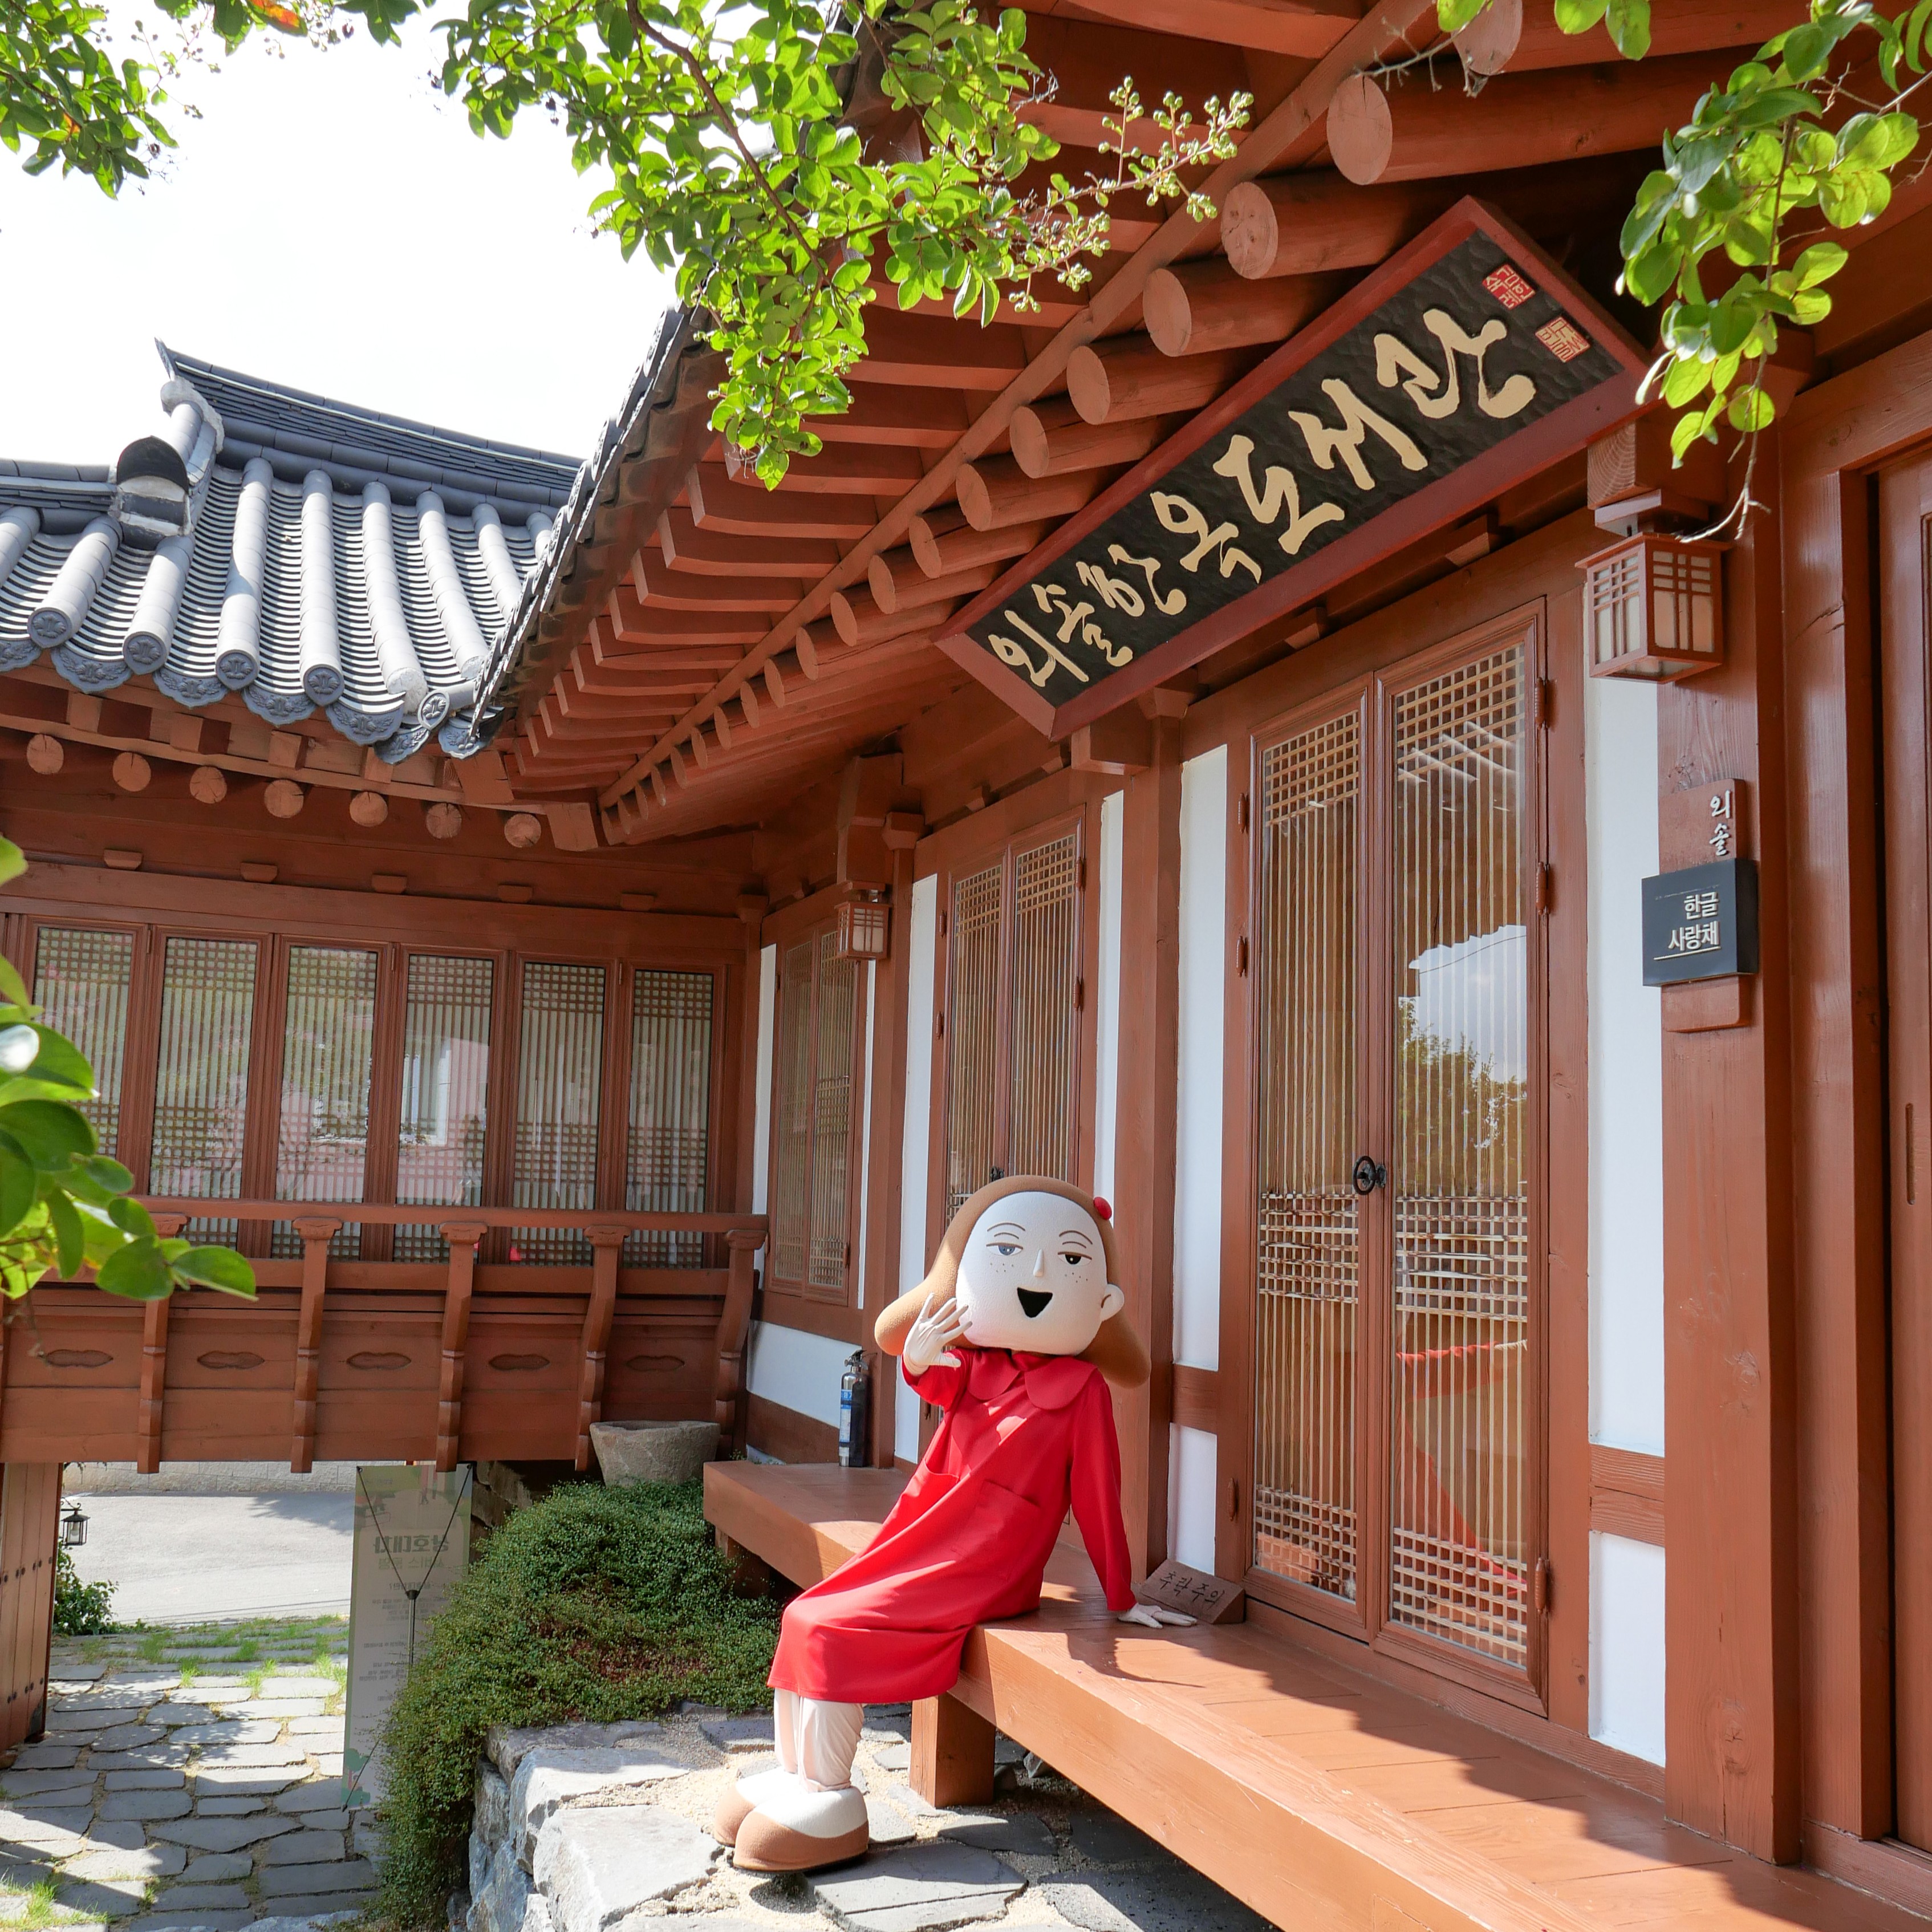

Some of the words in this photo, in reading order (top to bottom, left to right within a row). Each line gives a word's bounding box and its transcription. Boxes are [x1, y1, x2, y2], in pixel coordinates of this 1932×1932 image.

[1709, 790, 1731, 856] 외솔
[1684, 891, 1719, 919] 한글
[1668, 920, 1720, 951] 사랑채
